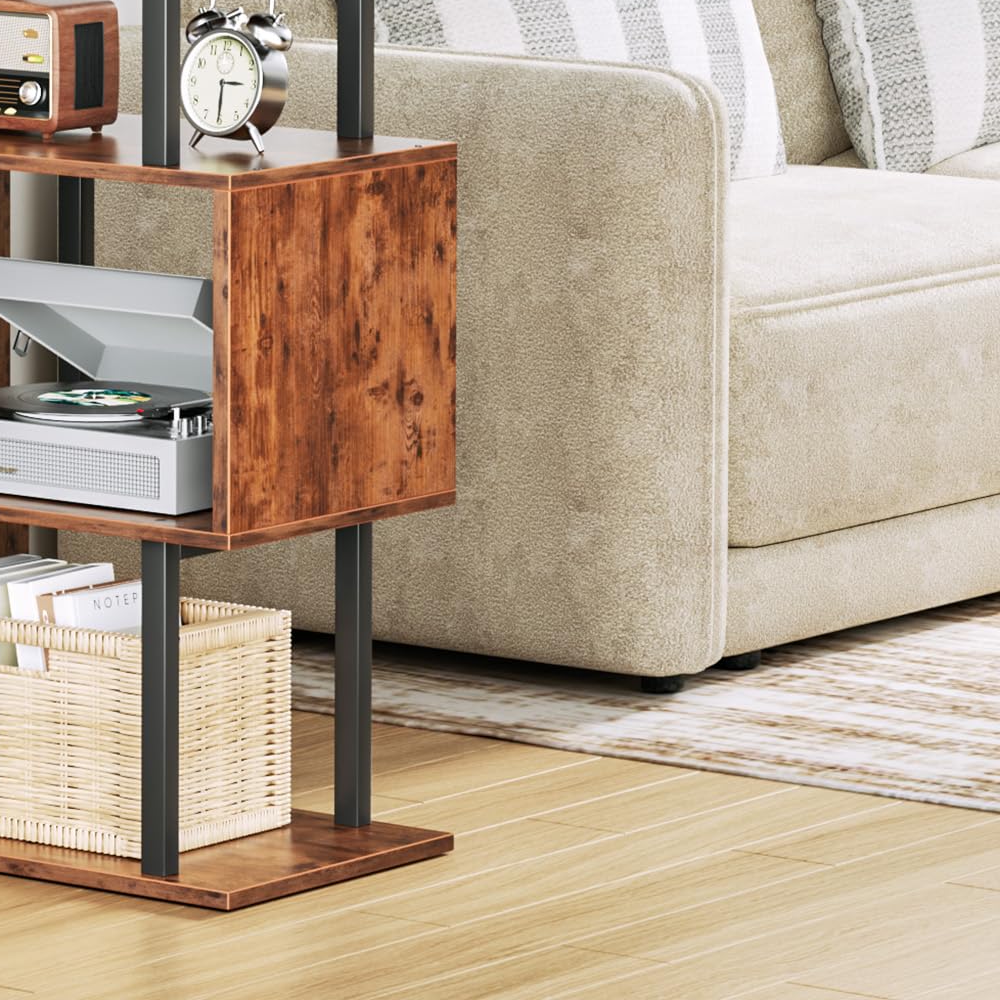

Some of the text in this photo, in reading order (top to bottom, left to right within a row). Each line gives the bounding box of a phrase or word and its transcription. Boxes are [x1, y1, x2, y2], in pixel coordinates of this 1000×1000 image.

[223, 40, 232, 51] 12
[197, 57, 207, 69] 10
[248, 59, 255, 71] 2
[251, 79, 257, 89] 3
[192, 95, 199, 105] 8
[203, 108, 209, 120] 7
